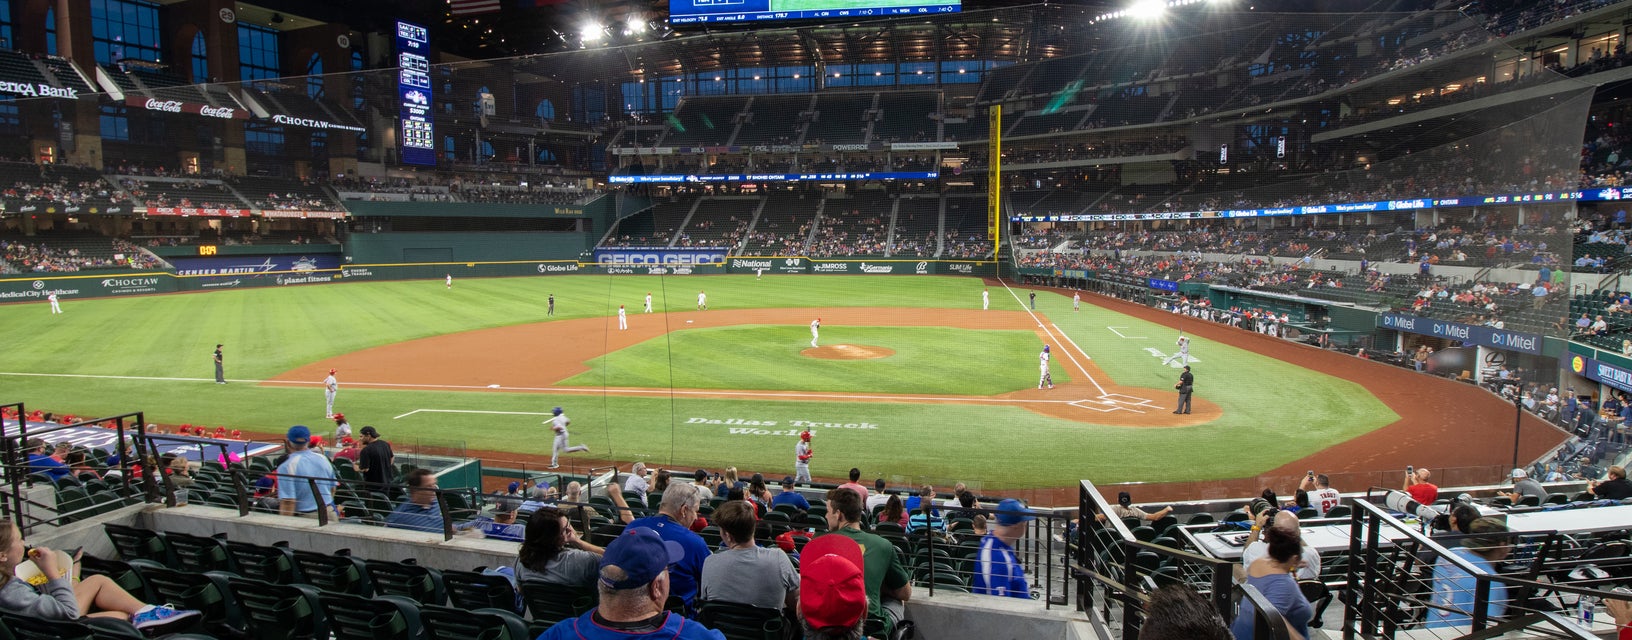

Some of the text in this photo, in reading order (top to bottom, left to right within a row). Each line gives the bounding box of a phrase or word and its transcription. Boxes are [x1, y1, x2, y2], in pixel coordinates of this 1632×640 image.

[39, 84, 79, 99] Bank
[279, 115, 328, 128] CHOCTAW
[200, 246, 216, 255] 0:09
[598, 254, 725, 265] GEICO GEICO
[108, 278, 158, 286] CHOCTAW
[1394, 316, 1414, 330] Mitel
[1446, 325, 1469, 339] Mitel
[1507, 334, 1535, 350] Mitel
[1598, 364, 1614, 378] SWEET
[1614, 369, 1627, 383] BABY
[684, 417, 878, 429] Dallas Truck
[1322, 499, 1337, 513] 27
